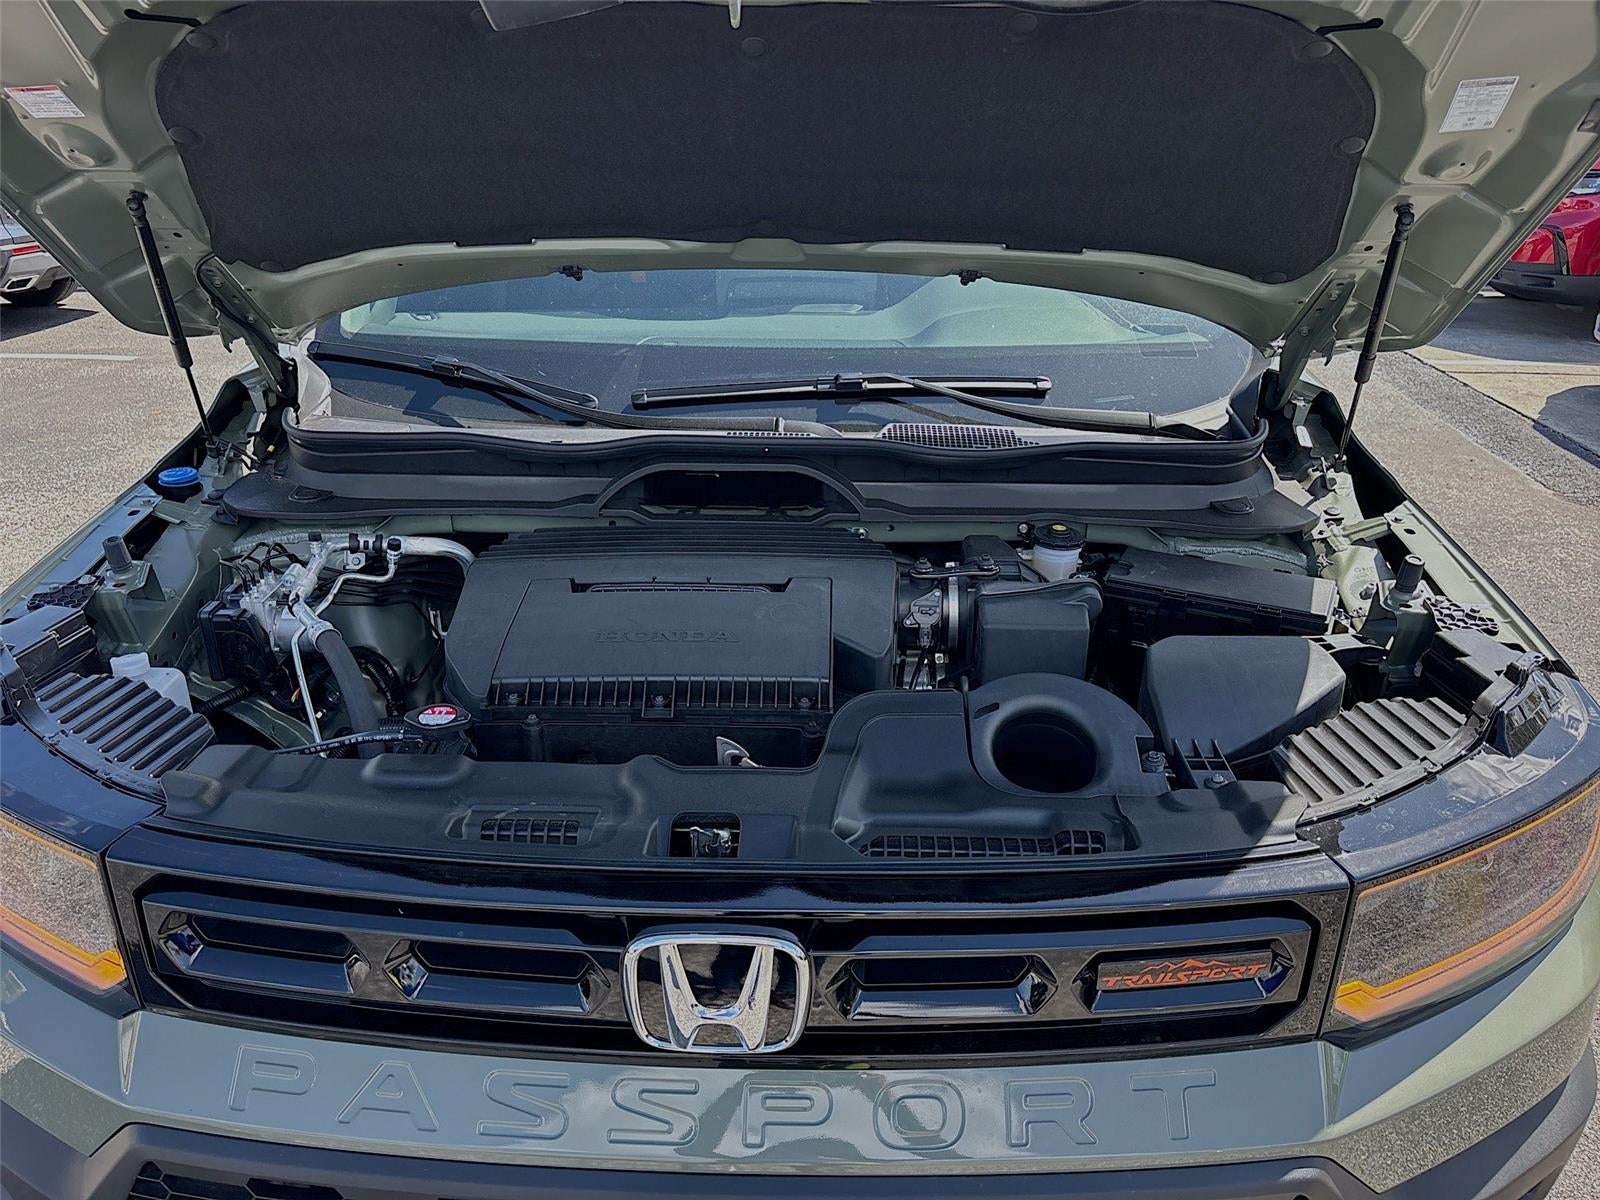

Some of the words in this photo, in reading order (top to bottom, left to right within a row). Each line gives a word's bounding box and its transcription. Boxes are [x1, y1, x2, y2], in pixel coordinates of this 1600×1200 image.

[594, 630, 740, 643] HONDA
[1102, 963, 1268, 988] TRAILSPORT
[228, 1043, 1217, 1151] PASSPORT
